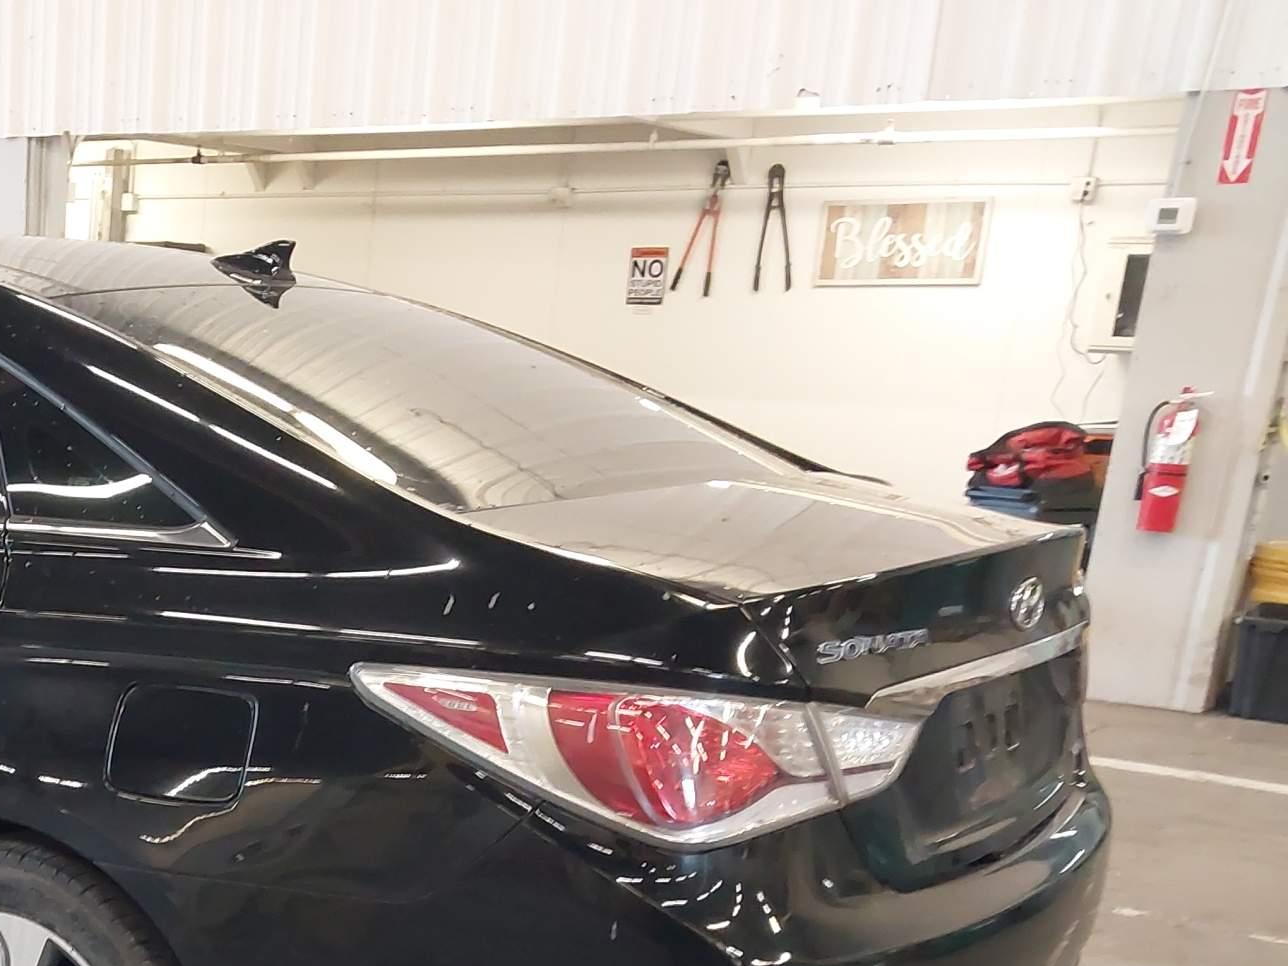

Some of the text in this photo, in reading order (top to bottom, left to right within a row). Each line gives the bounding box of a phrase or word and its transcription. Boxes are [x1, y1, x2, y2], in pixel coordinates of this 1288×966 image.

[830, 216, 977, 268] Blessed
[631, 259, 664, 278] NO
[816, 628, 929, 664] SONATA
